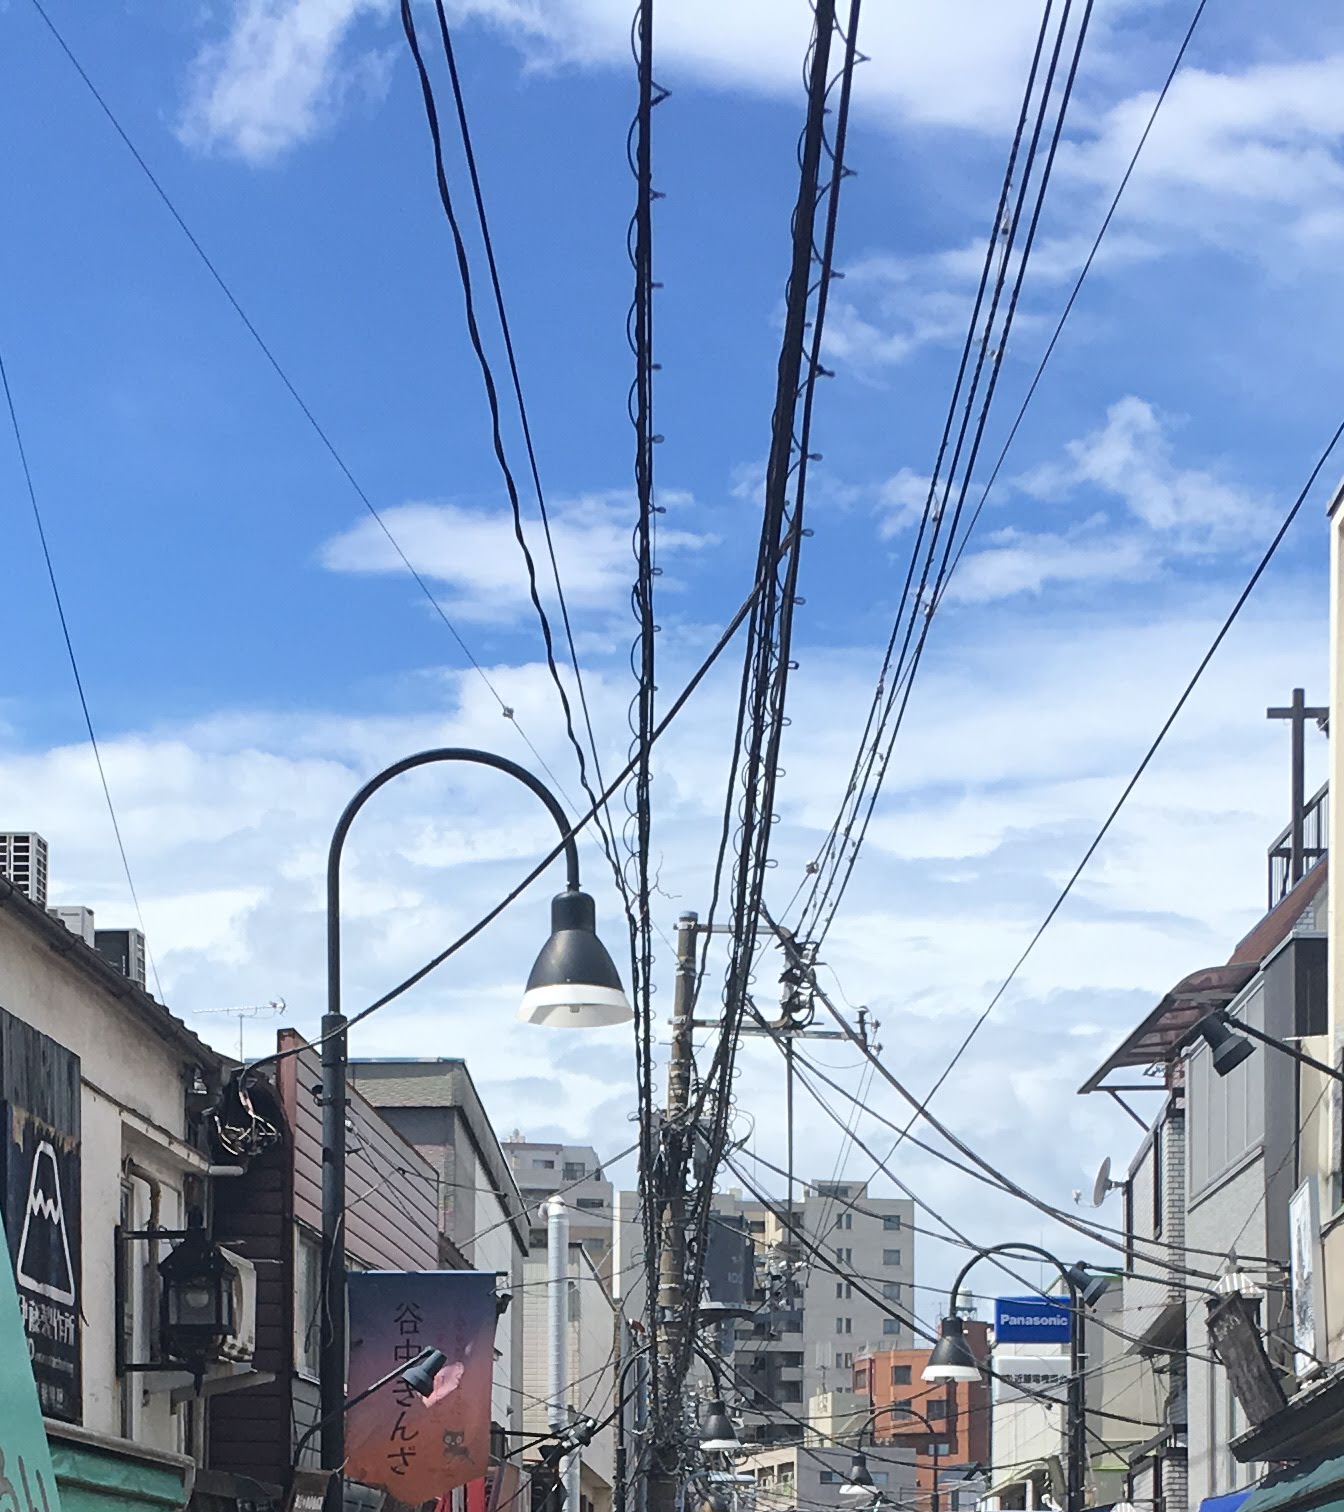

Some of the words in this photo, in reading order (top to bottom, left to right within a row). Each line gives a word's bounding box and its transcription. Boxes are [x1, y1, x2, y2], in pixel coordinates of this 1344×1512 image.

[1000, 1314, 1069, 1327] Panasonic
[387, 1301, 422, 1476] 谷中ぎんざ
